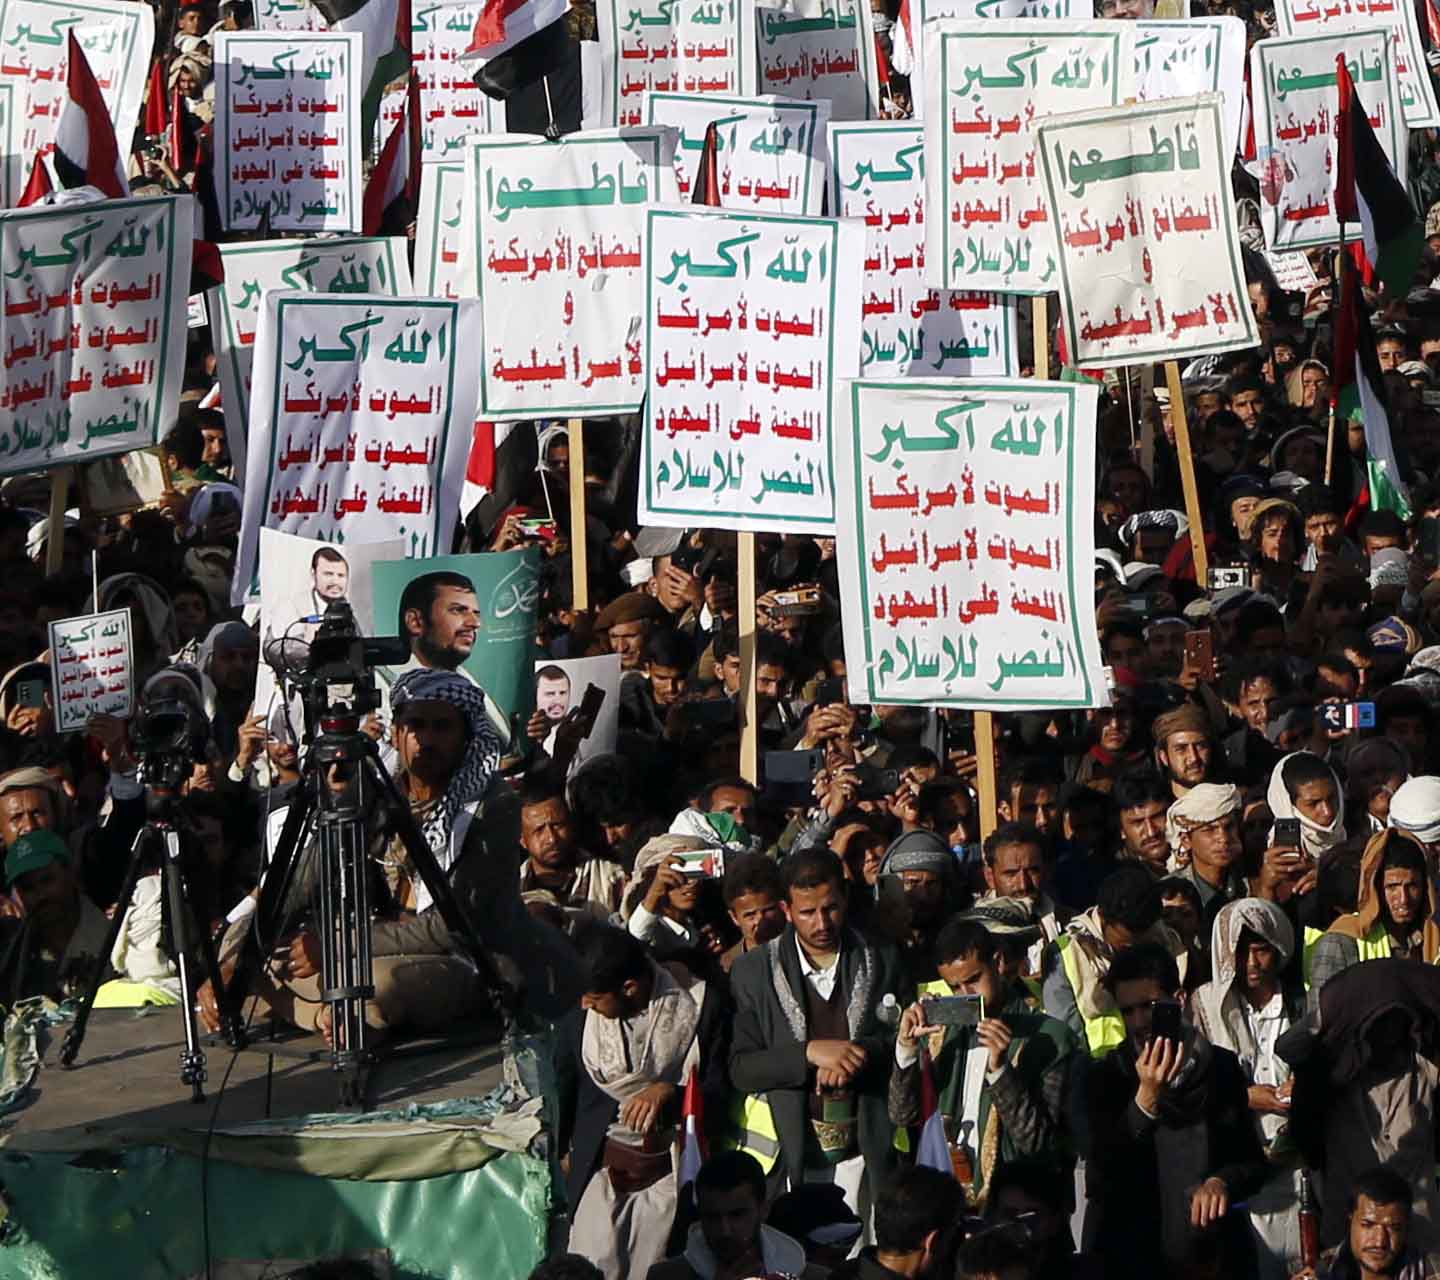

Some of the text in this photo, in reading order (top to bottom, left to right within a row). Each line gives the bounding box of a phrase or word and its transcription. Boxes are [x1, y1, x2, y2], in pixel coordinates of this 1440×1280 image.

[1055, 122, 1200, 198] قاطعوا
[486, 160, 647, 222] قاطعوا
[1062, 192, 1219, 257] البضائع الأمريكية
[577, 232, 641, 279] لبضائع
[657, 225, 827, 293] الله أكبر
[1142, 247, 1152, 284] و
[563, 291, 574, 325] و
[657, 297, 823, 341] الموت لأمريكا
[1081, 292, 1238, 348] الإسرائيلية
[493, 339, 642, 391] لإسرائيلية
[655, 350, 821, 394] الموت لإسرائيل
[655, 402, 822, 441] اللعنة على اليهود
[867, 395, 1063, 470] الله أكبر
[656, 447, 824, 504] النصر للإسلام
[868, 463, 1060, 517] الموت لأمريكا
[871, 526, 1060, 573] الموت لإسرائيل
[873, 581, 1065, 627] اللعنة على اليهود
[878, 629, 1076, 696] النصر للإسلام
